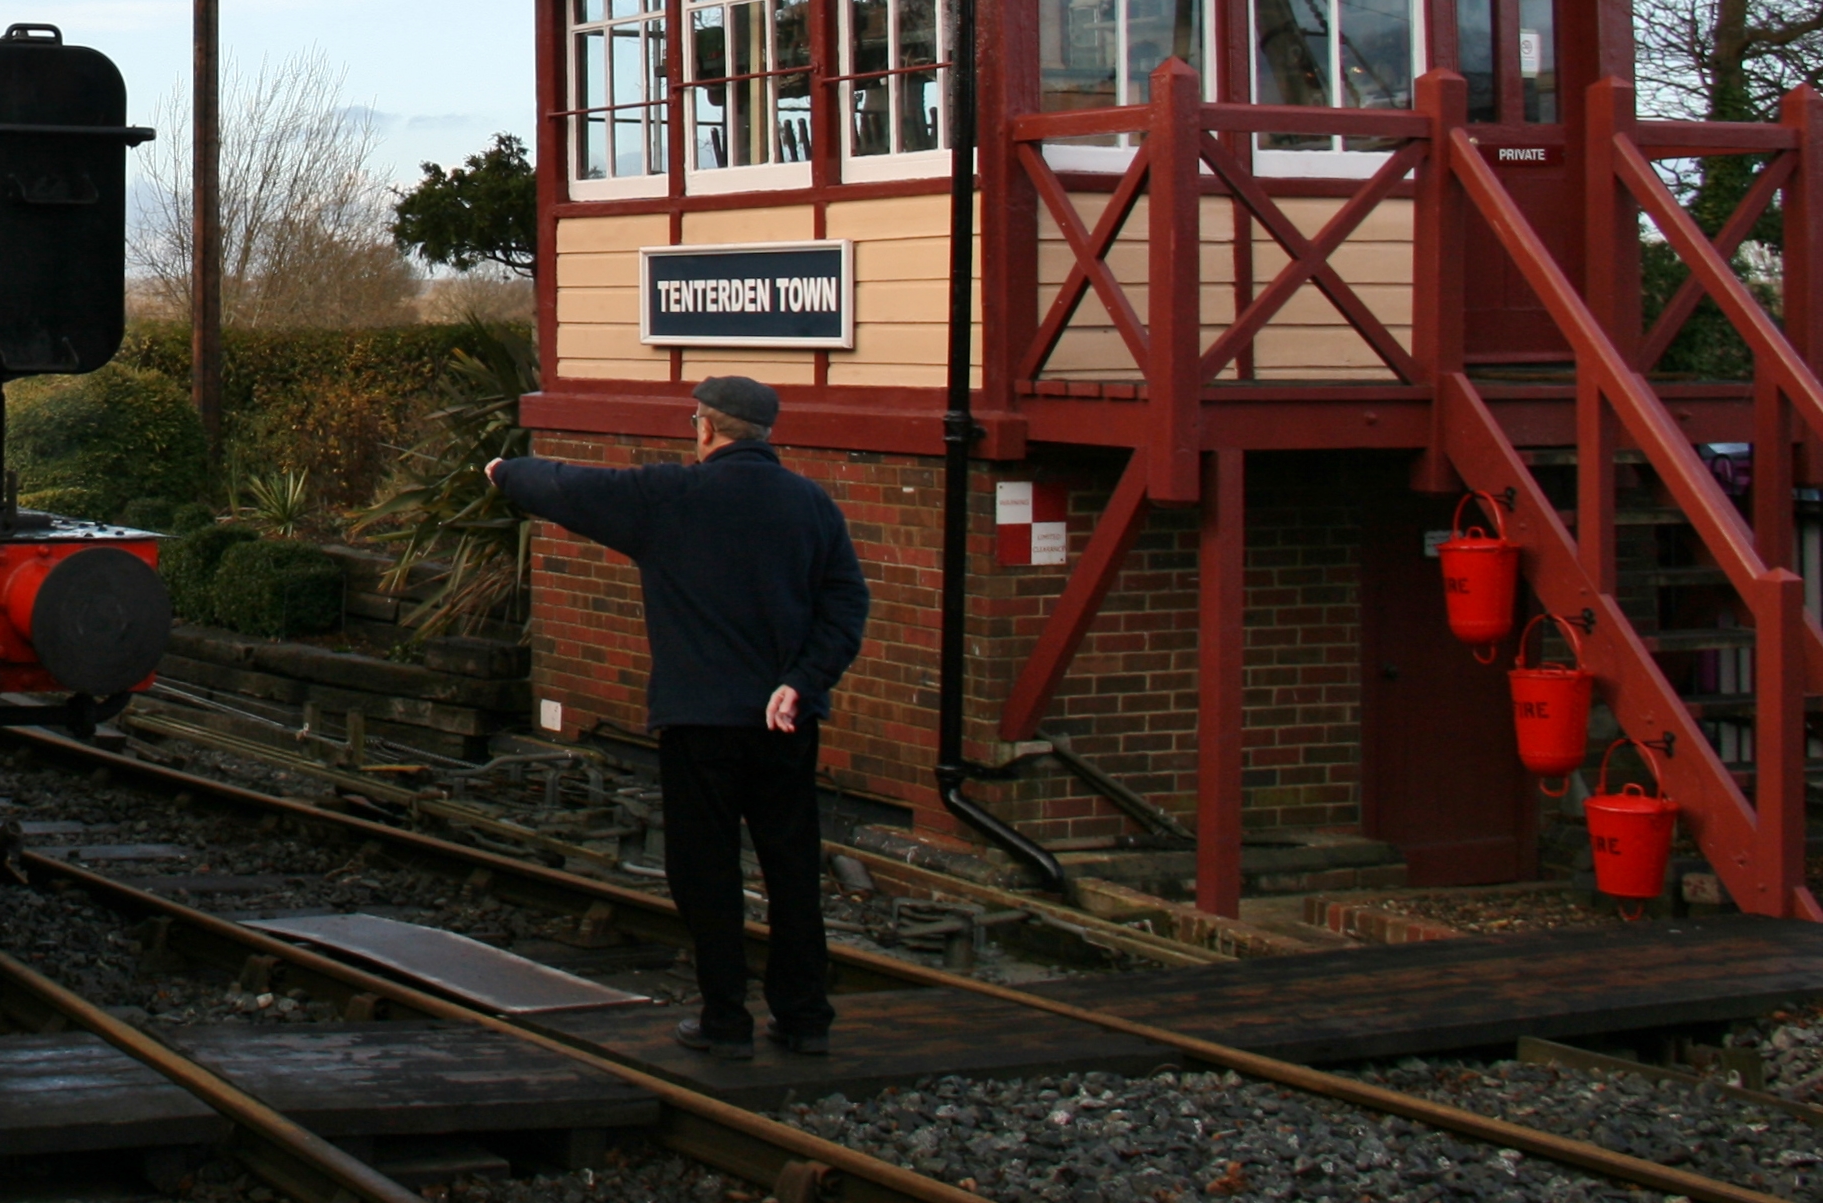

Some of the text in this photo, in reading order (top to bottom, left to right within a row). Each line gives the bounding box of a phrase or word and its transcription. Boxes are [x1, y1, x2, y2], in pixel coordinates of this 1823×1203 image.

[1499, 148, 1546, 161] PRIVATE
[657, 277, 837, 313] TENTERDEN TOWN
